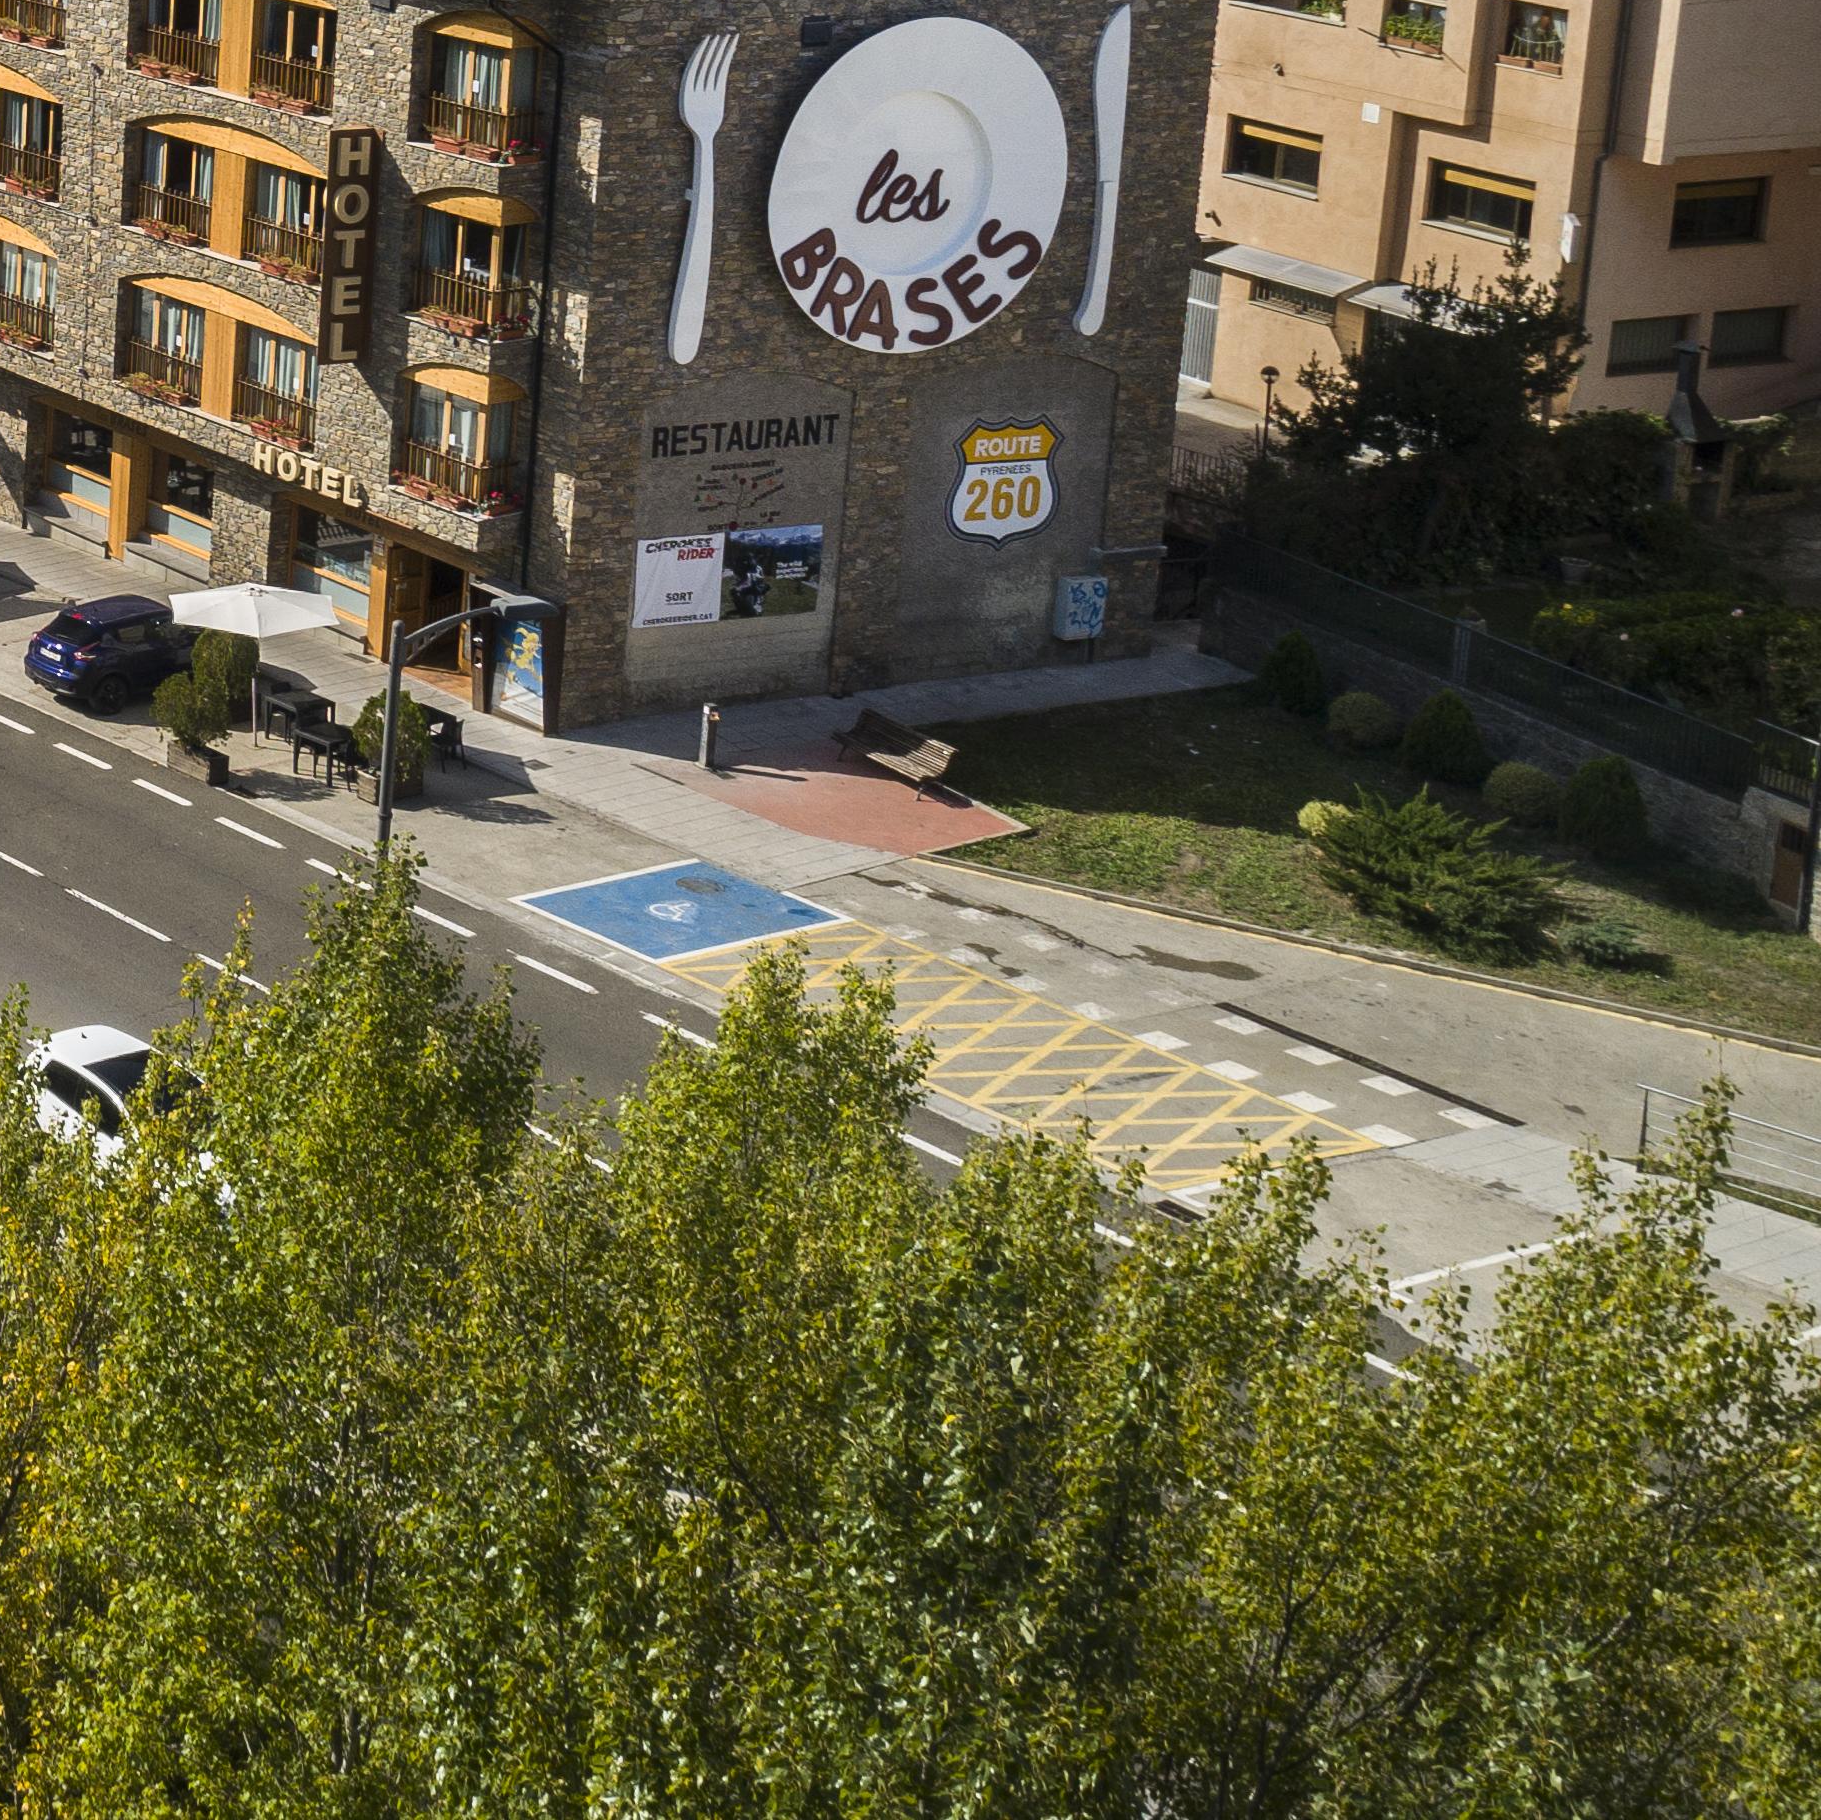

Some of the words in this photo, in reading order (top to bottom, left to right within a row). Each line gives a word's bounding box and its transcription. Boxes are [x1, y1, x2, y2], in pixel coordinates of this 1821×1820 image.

[856, 149, 950, 223] les
[329, 137, 371, 360] HOTEL
[781, 219, 1042, 350] BRASES
[651, 413, 840, 458] RESTAURANT
[974, 435, 1042, 457] ROUTE
[253, 441, 363, 507] HOTEL
[980, 464, 1032, 476] PYRENEES
[963, 475, 1041, 521] 260
[645, 538, 712, 554] CHEROKEE
[677, 547, 716, 561] RIDER
[665, 591, 694, 602] SORT
